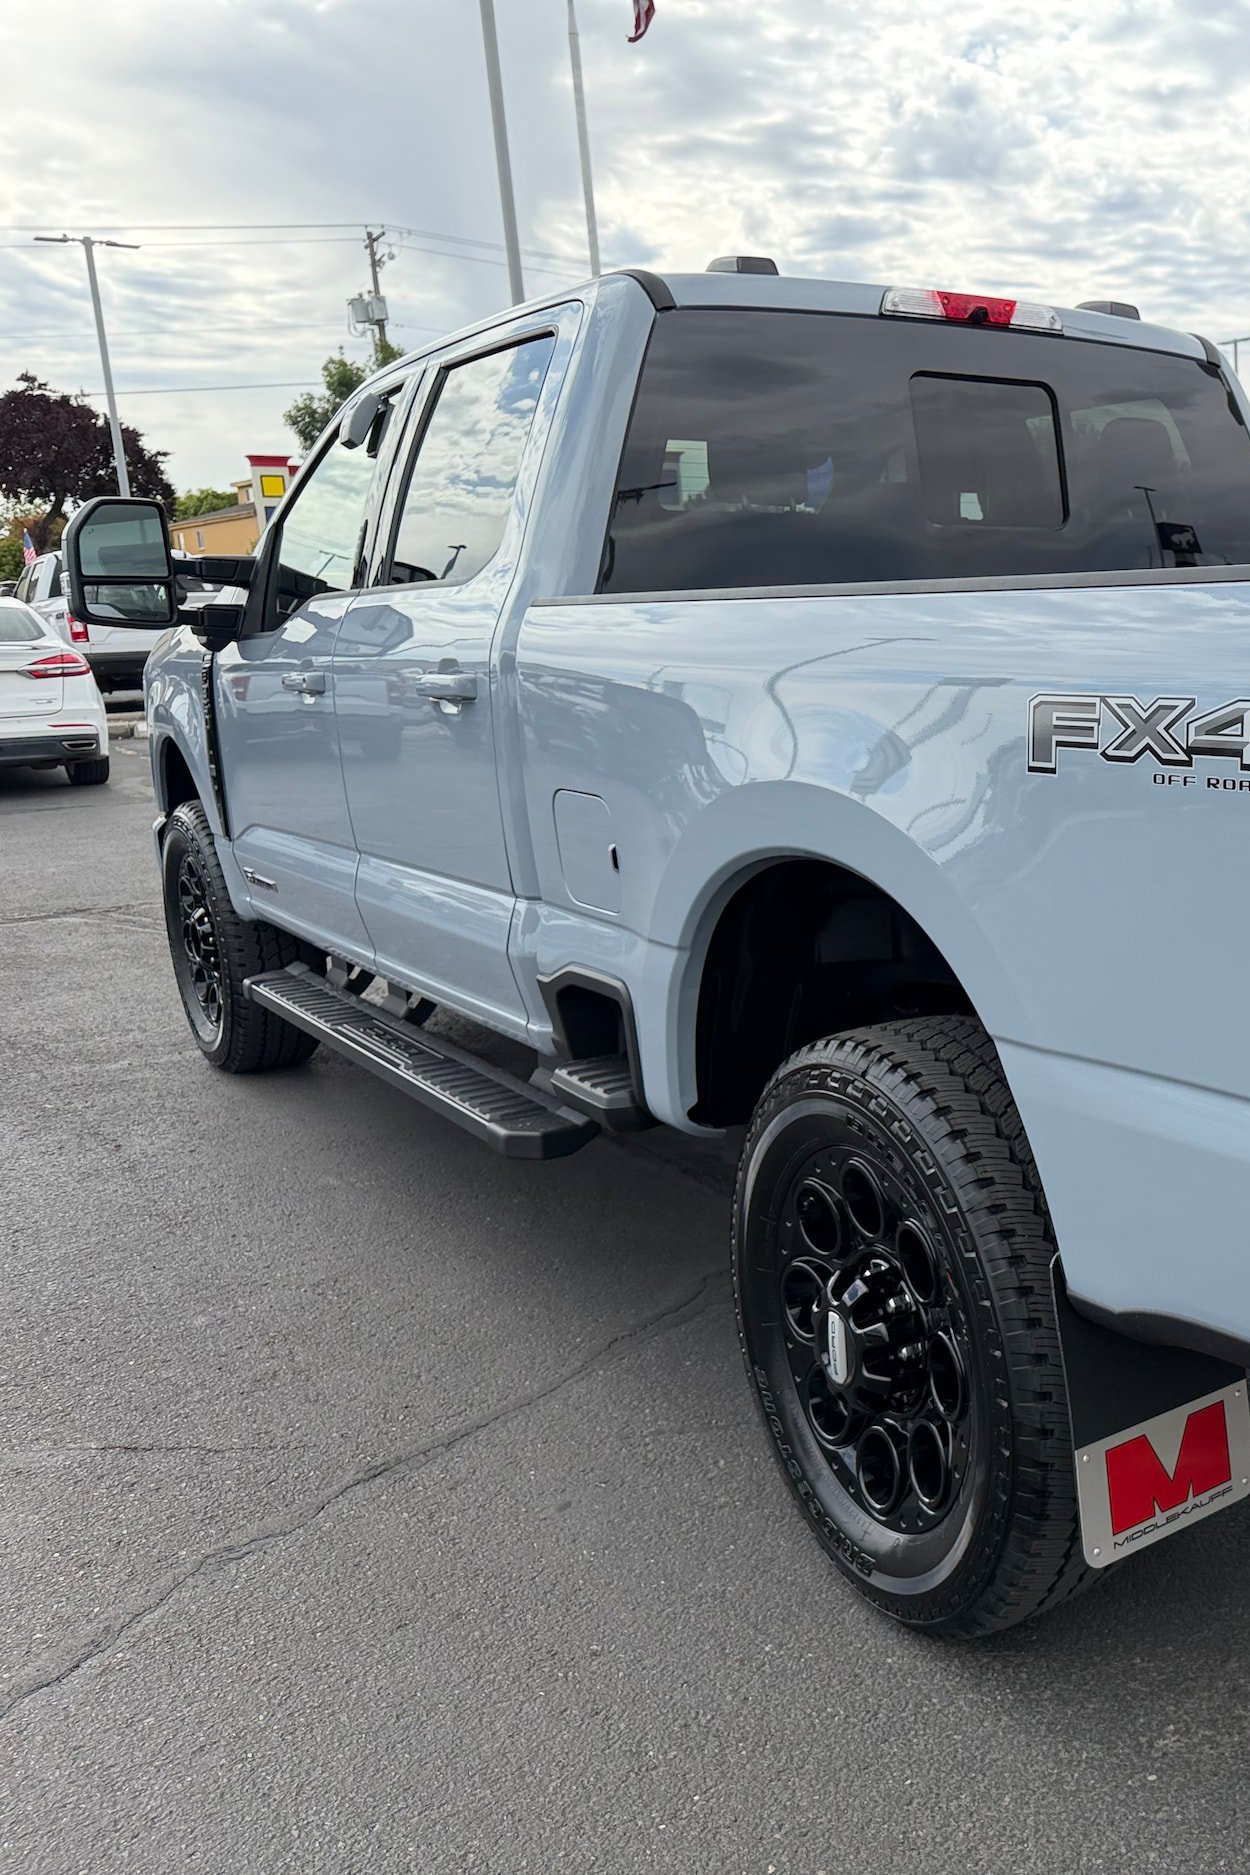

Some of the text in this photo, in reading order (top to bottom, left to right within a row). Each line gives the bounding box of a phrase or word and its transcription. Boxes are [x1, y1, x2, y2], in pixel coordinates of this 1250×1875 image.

[1152, 772, 1198, 788] OFF
[829, 1320, 839, 1376] FORD
[754, 1365, 877, 1578] BRIDGESTONE
[1105, 1400, 1232, 1537] M
[1113, 1485, 1233, 1549] MIDDLEKAUFF
